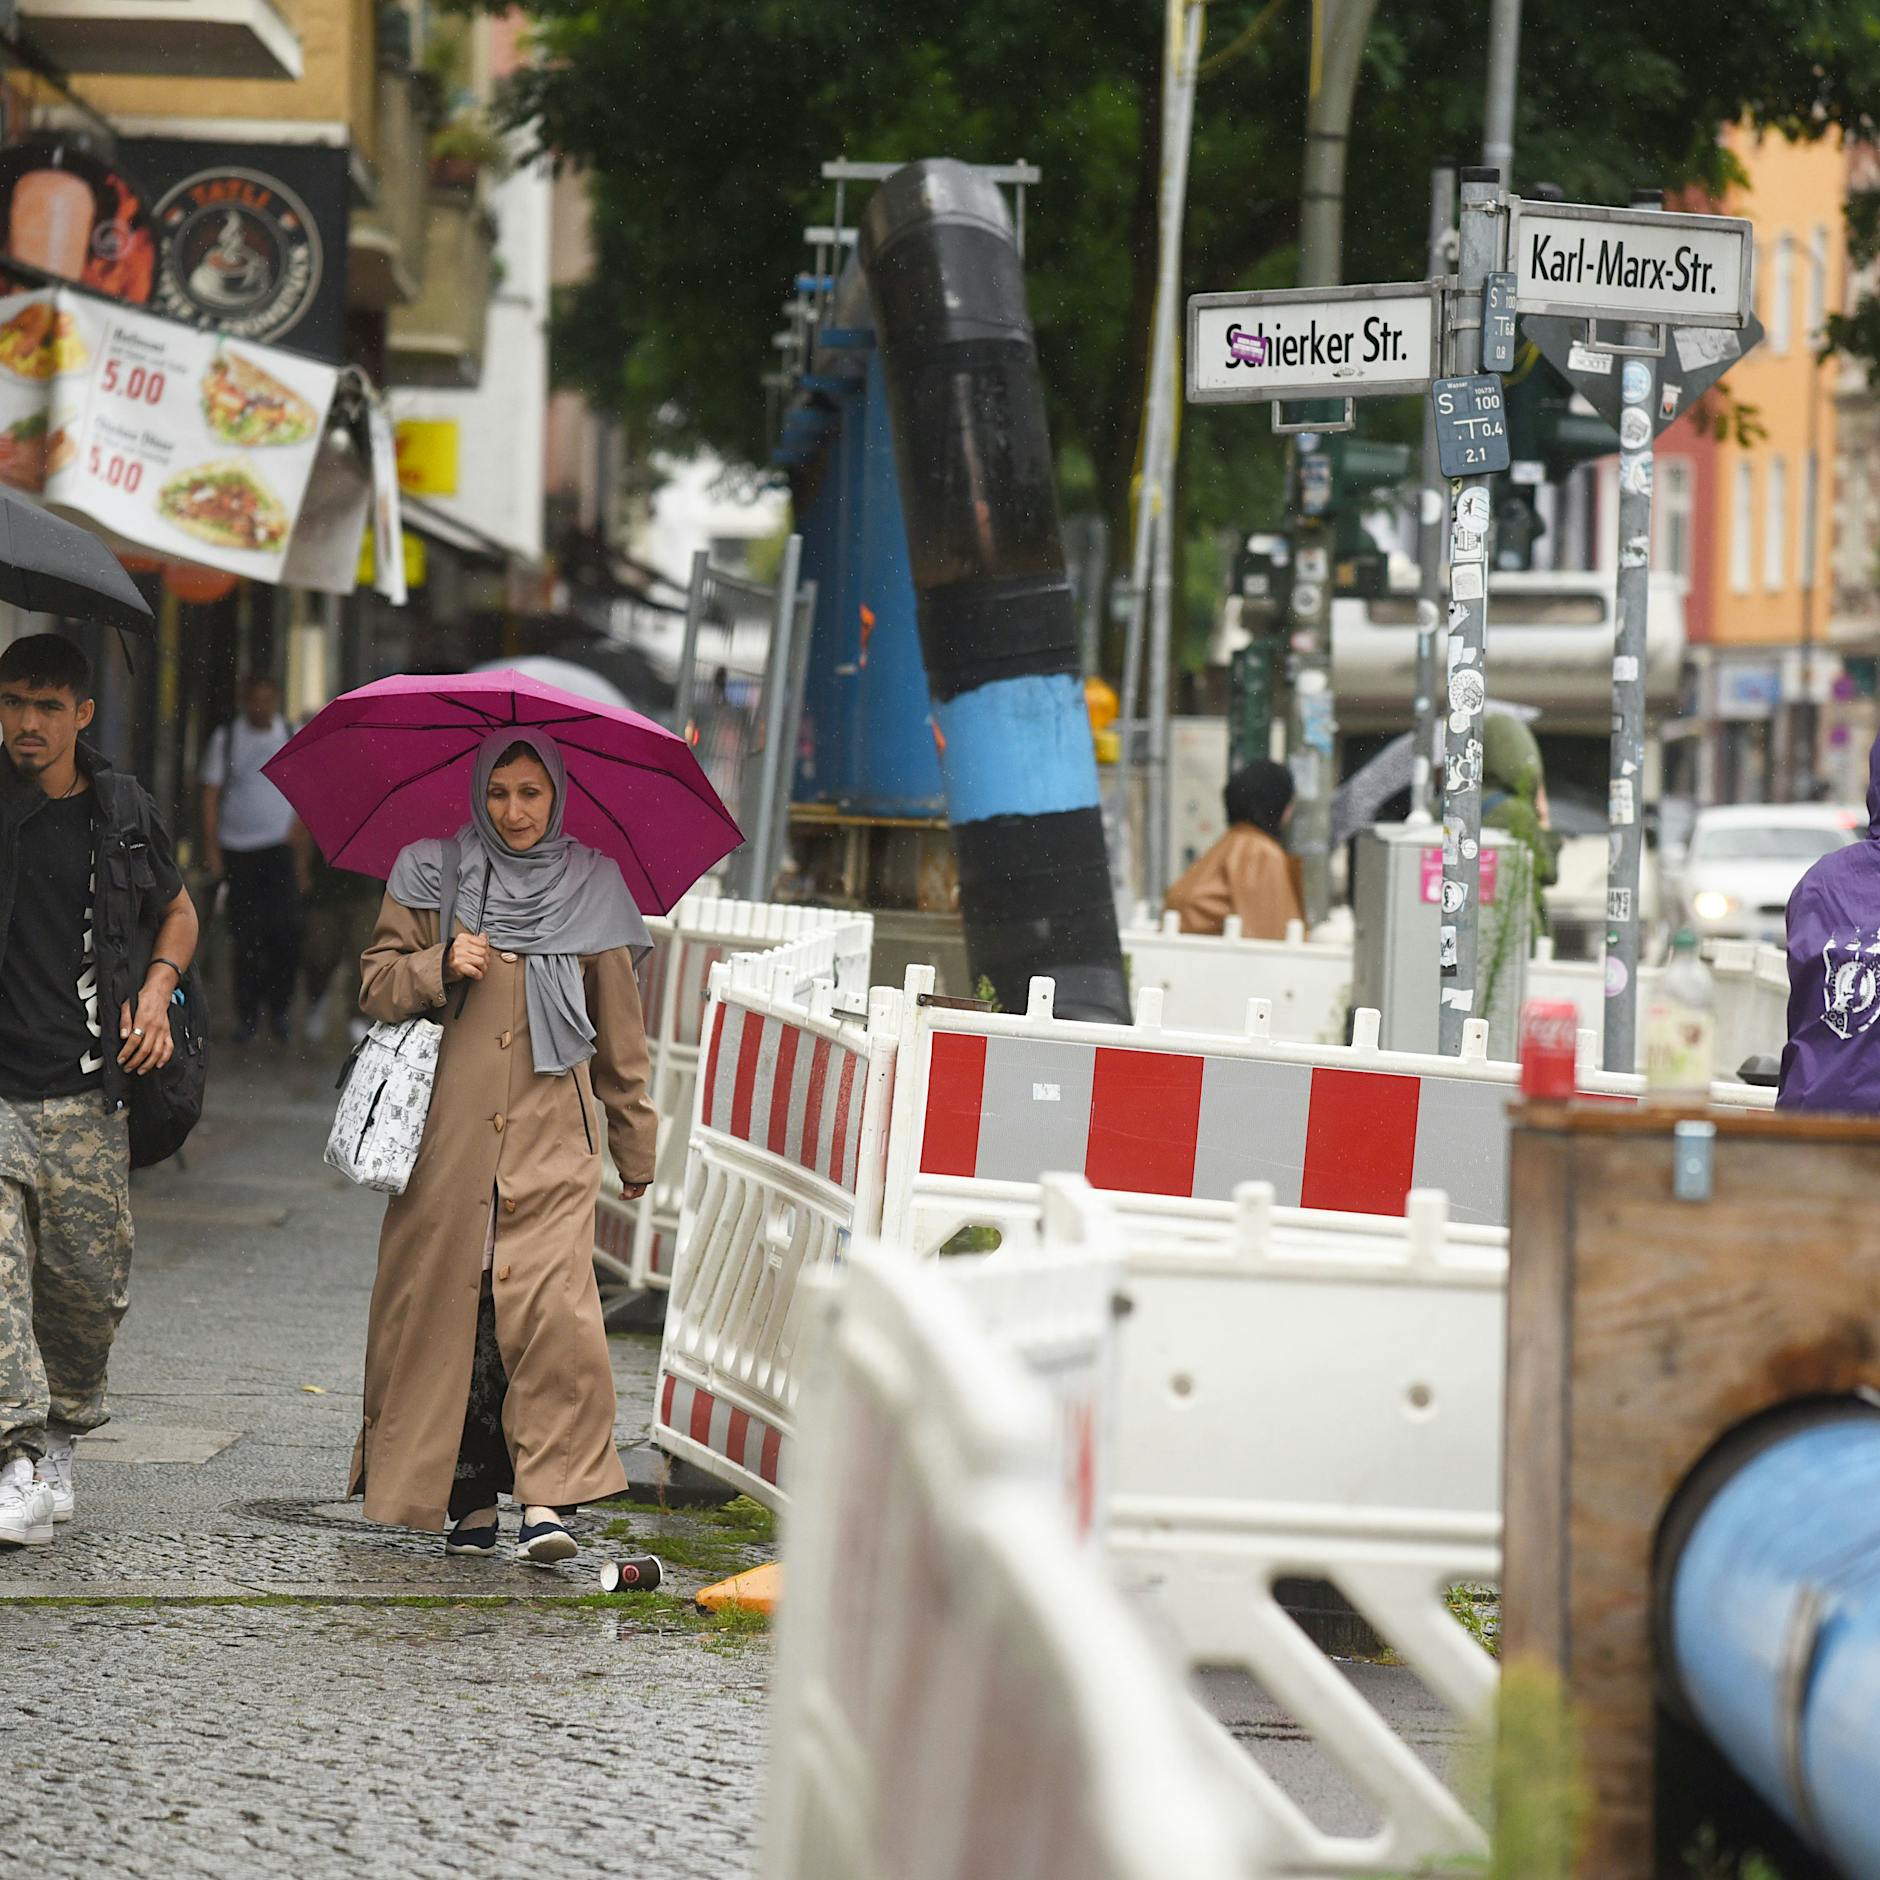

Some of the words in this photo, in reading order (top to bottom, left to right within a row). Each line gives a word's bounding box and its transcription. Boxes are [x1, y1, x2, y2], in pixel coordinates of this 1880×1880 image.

[1530, 233, 1717, 294] Karl-Marx-Str.
[1225, 320, 1354, 369] Shierker
[1363, 316, 1407, 362] Str.
[102, 358, 165, 405] 5.00
[1438, 393, 1454, 415] S
[1475, 395, 1500, 411] 100
[1482, 421, 1503, 437] 0.4
[88, 445, 143, 493] 5.00
[1465, 447, 1486, 463] 2.1
